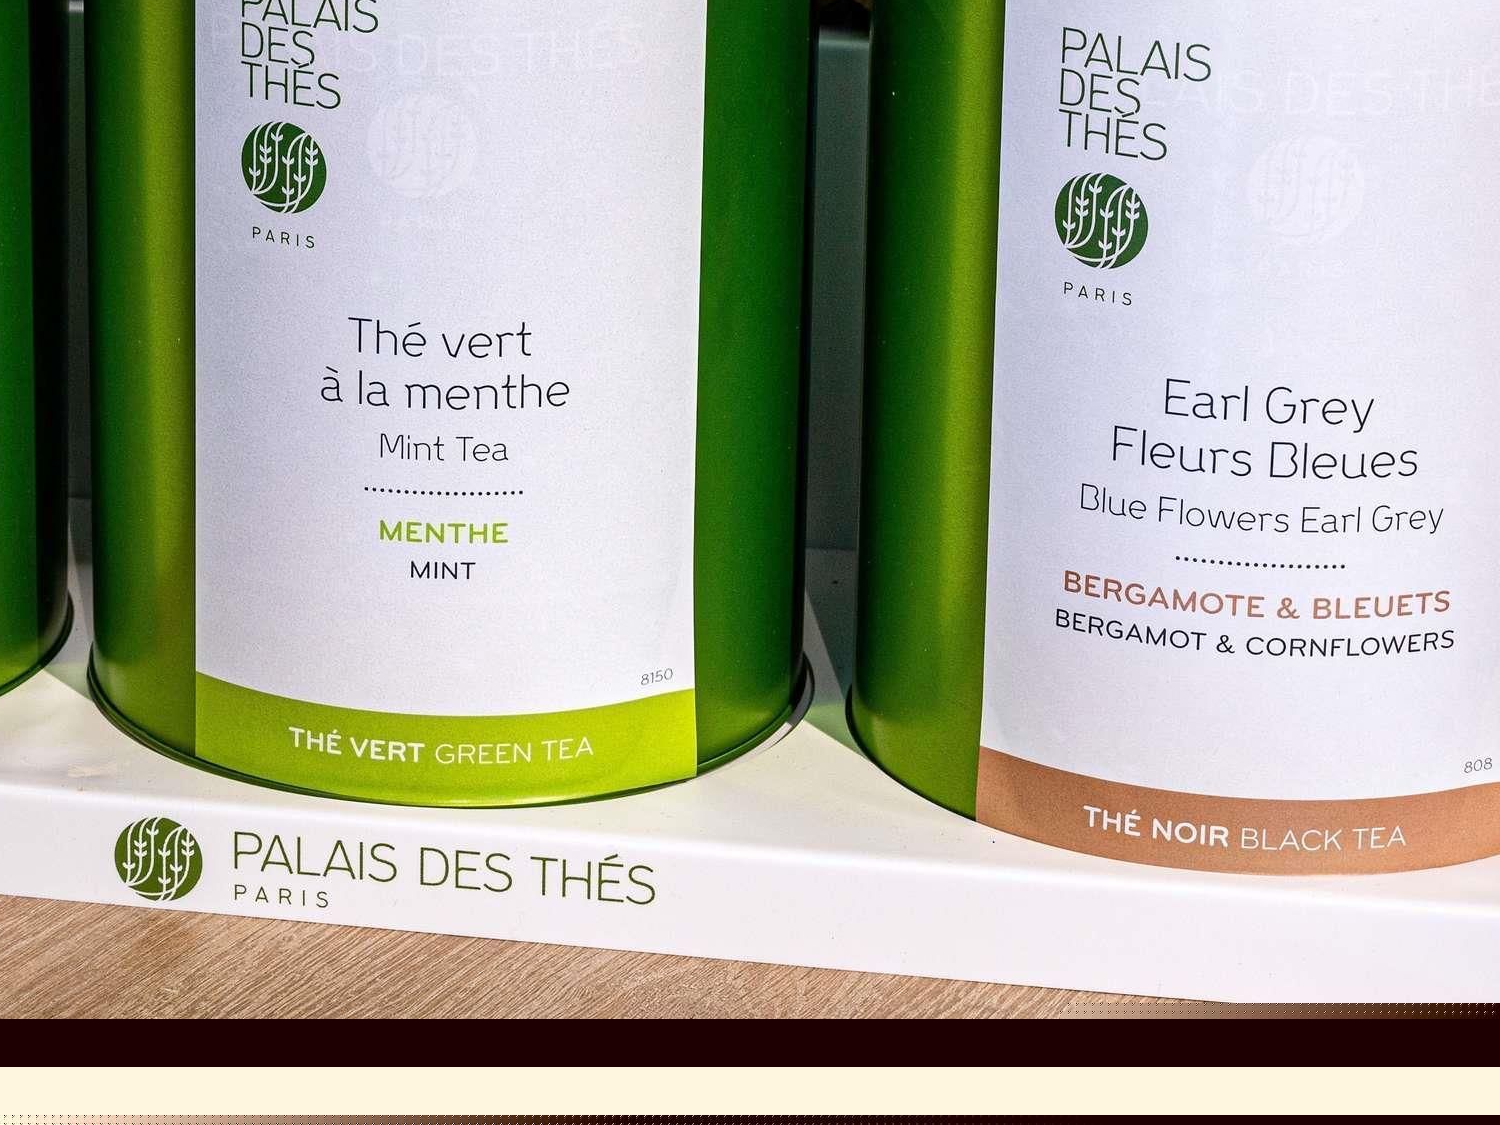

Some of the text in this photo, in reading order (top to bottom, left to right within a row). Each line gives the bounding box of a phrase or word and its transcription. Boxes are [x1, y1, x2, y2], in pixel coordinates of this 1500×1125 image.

[241, 22, 315, 66] DES
[1062, 27, 1212, 82] PALAIS
[241, 61, 342, 110] THÉS
[1059, 68, 1141, 114] DES
[1059, 108, 1168, 161] THÉS
[252, 226, 316, 249] PARIS
[1063, 281, 1133, 306] PARIS
[348, 317, 532, 358] Thé vert
[321, 366, 570, 411] à la menthe
[1164, 377, 1375, 433] Earl Grey
[380, 433, 509, 463] Mint Tea
[1112, 425, 1418, 479] Fleurs Bleues
[1080, 482, 1444, 535] Blue Flowers Earl Grey
[379, 520, 509, 544] MENTHE
[410, 561, 476, 580] MINT
[1063, 569, 1451, 620] BERGAMOTE & BLEUETS
[1055, 608, 1455, 657] BERGAMOT & CORNFLOWERS
[640, 668, 674, 686] 8150
[289, 727, 594, 764] THÉ VERT GREEN TEA
[1463, 757, 1493, 774] 808
[1083, 804, 1406, 851] THÉ NOIR BLACK TEA
[233, 830, 657, 907] PALAIS DES THÉS
[233, 883, 329, 909] PARIS
